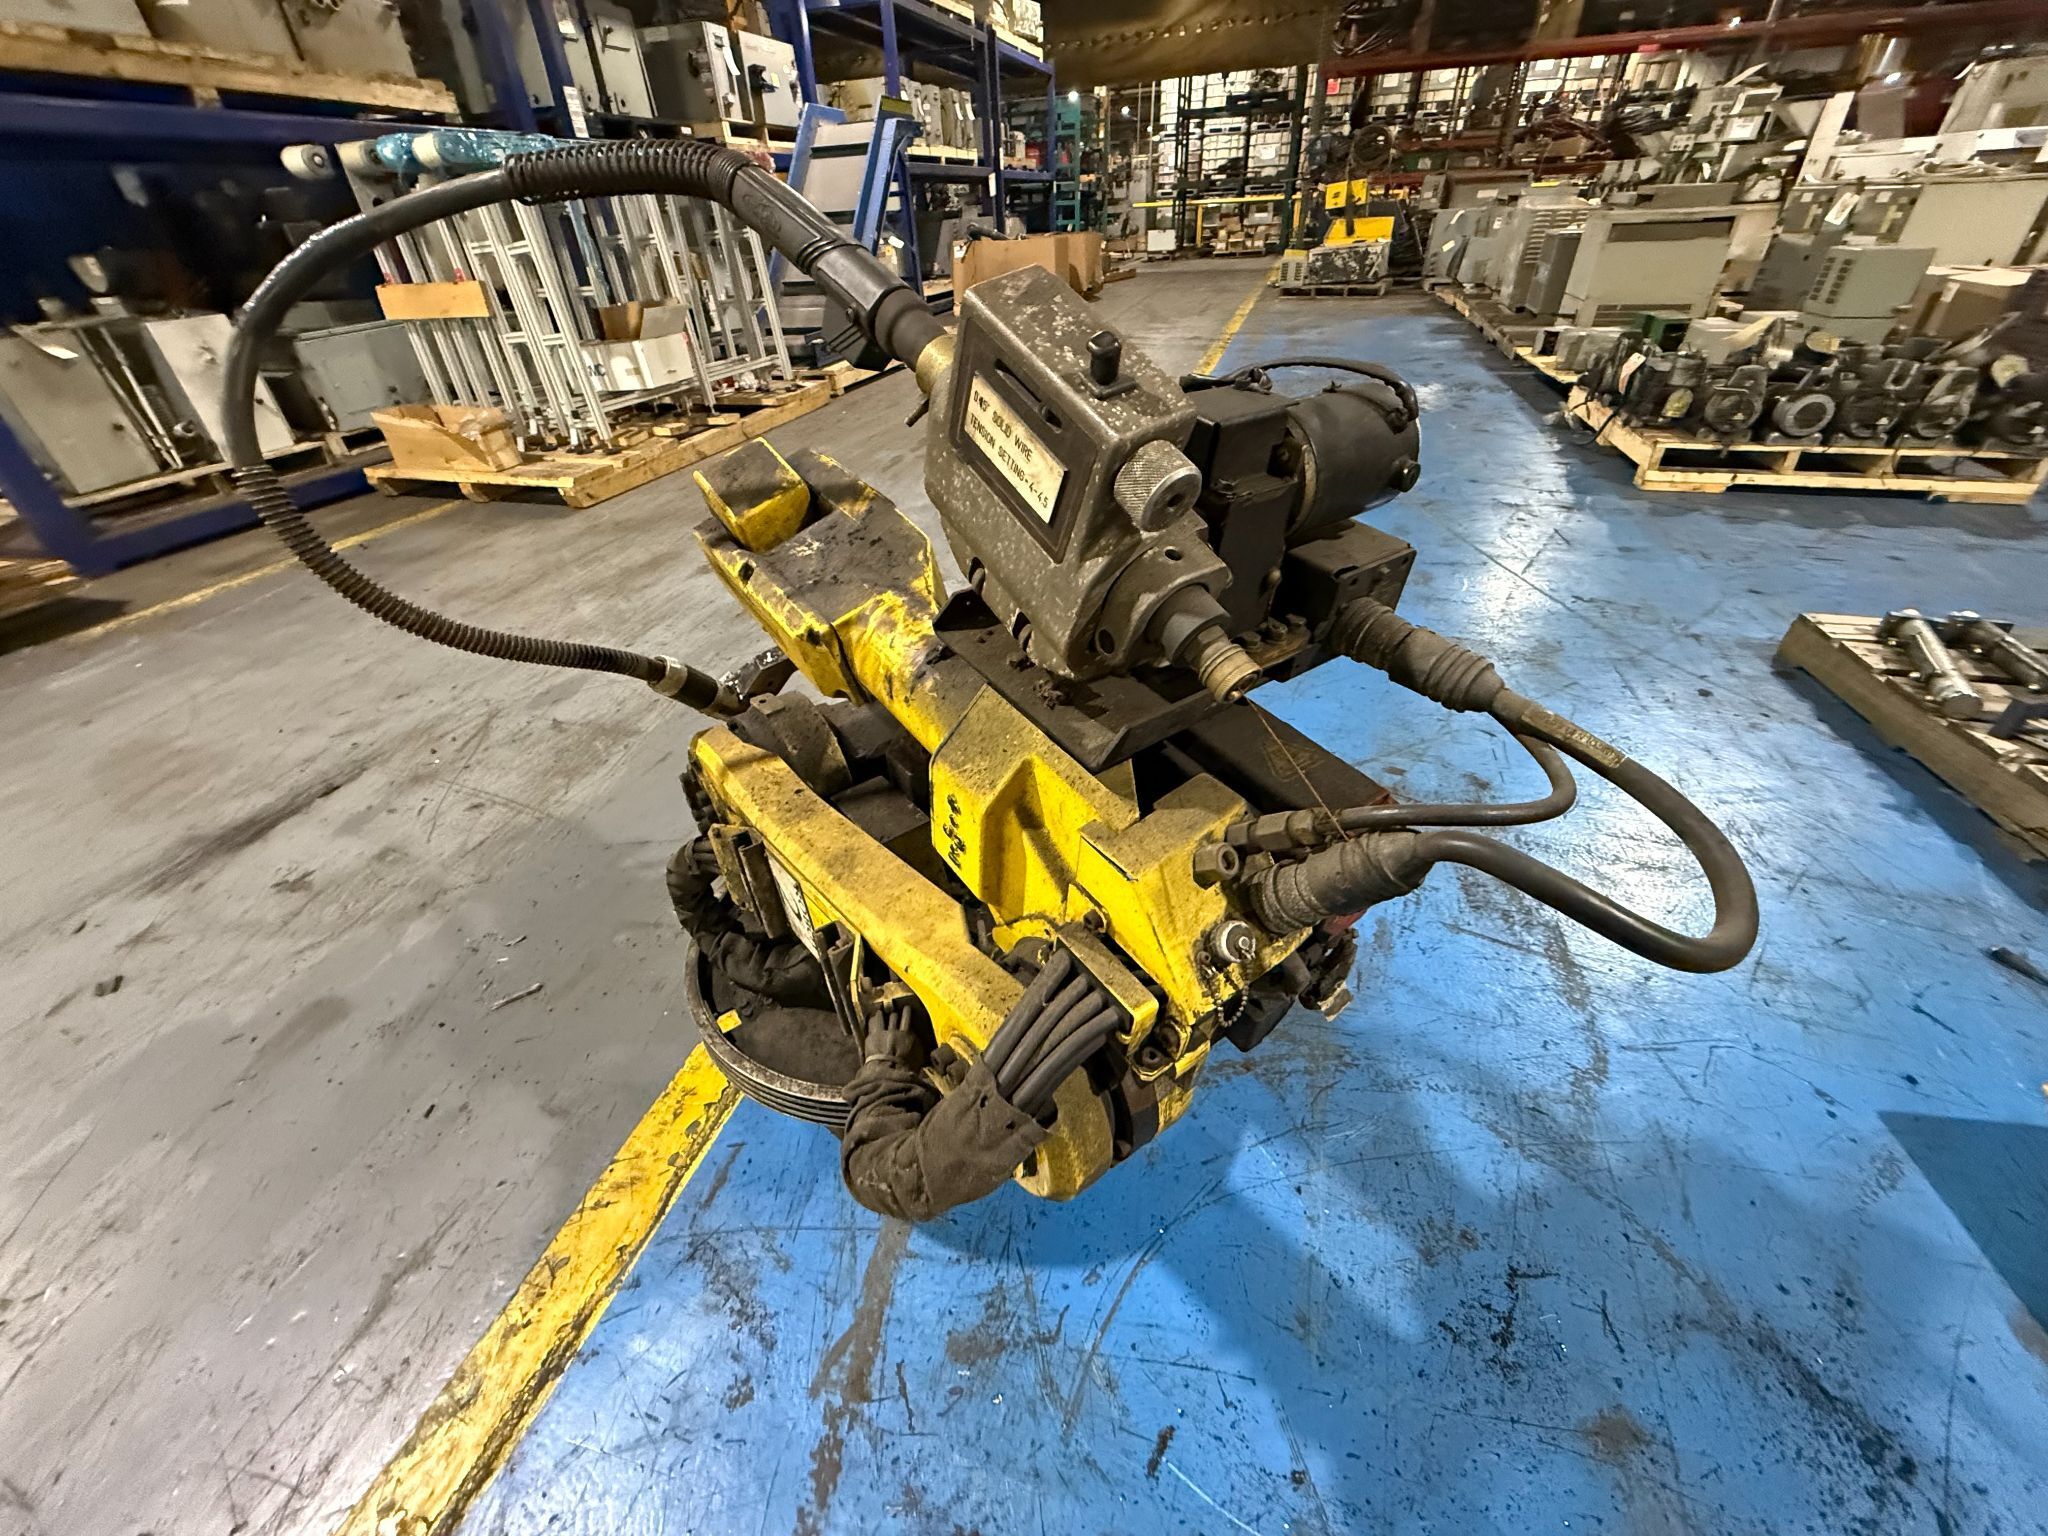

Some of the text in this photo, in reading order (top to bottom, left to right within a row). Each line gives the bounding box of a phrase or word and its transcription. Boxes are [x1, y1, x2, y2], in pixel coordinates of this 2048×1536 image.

[970, 412, 995, 449] TENSION
[992, 410, 1012, 438] SOLID
[1014, 434, 1033, 463] WIRE
